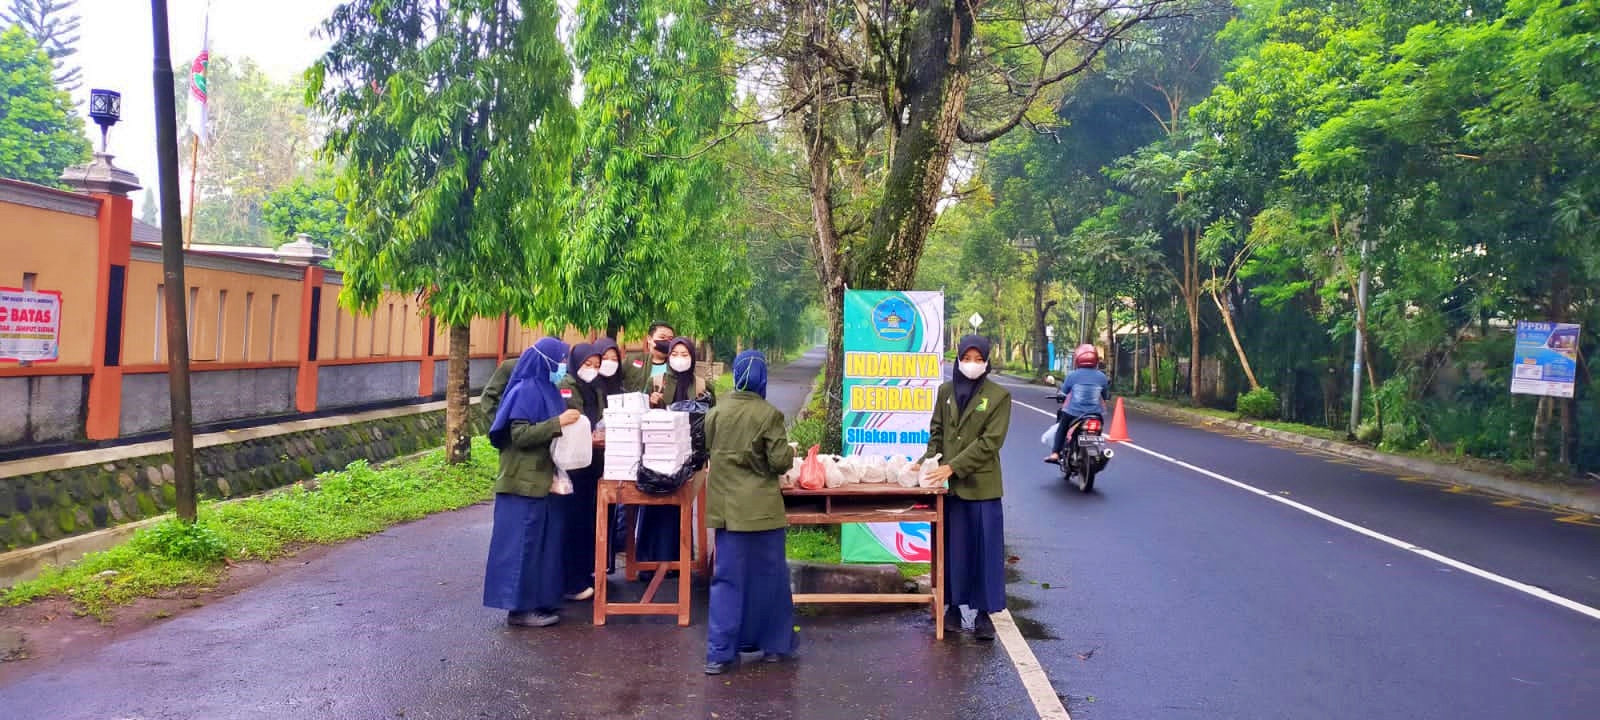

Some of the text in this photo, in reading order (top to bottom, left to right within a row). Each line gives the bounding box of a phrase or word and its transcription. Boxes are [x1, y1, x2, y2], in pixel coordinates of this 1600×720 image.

[11, 307, 52, 323] BATAS
[846, 353, 939, 378] INDAHNYA
[851, 386, 934, 411] BERBAGI
[847, 428, 930, 444] Silakan amb
